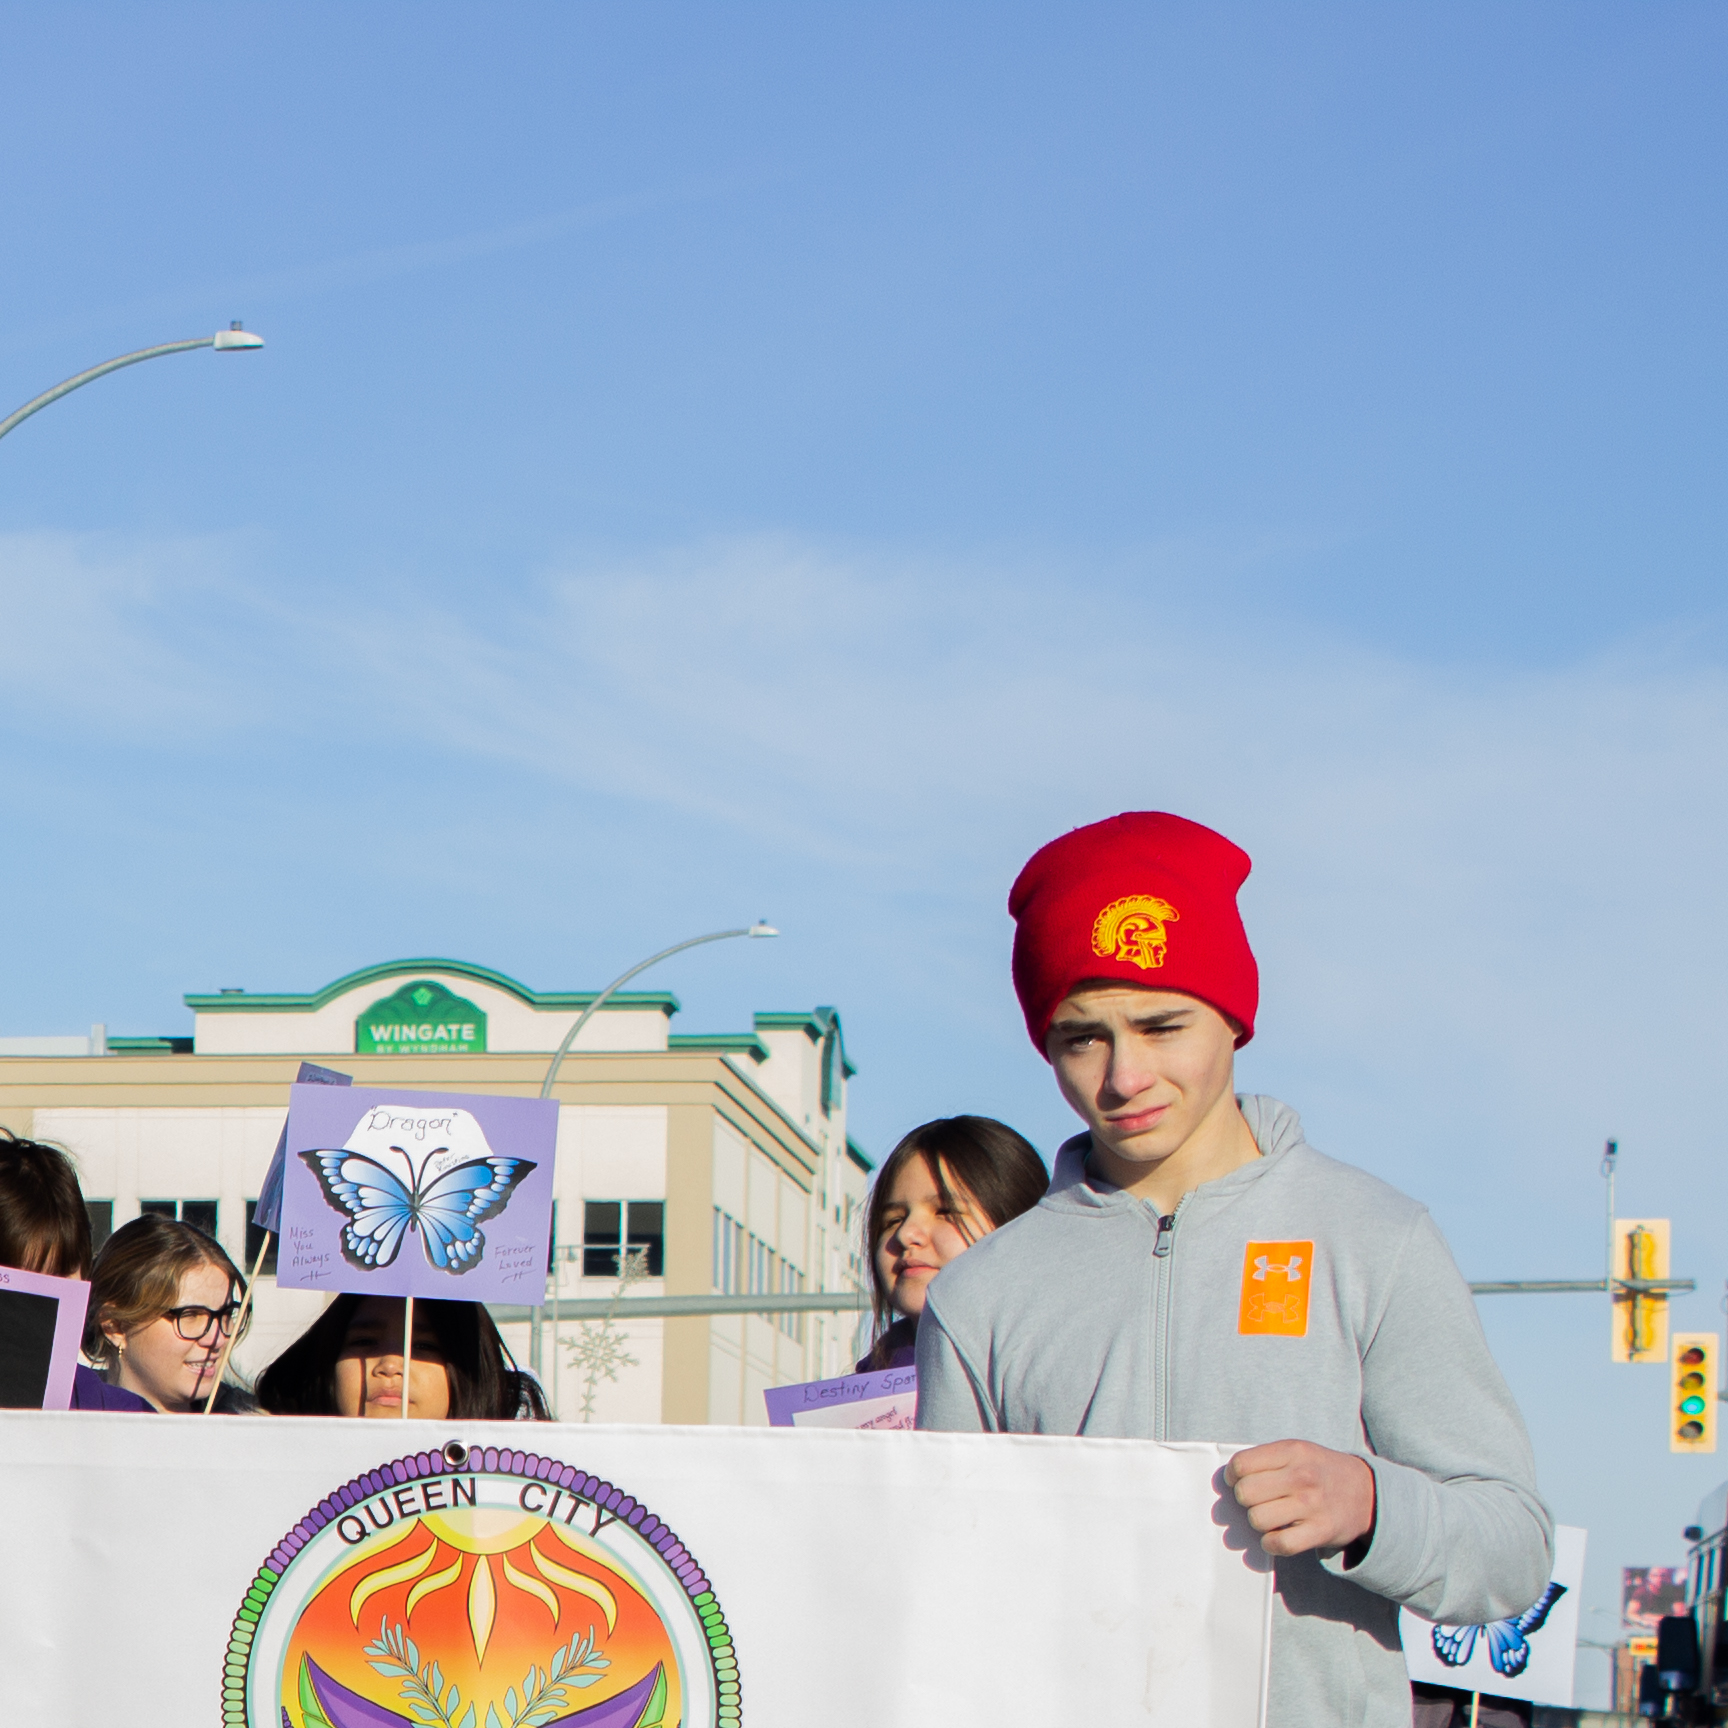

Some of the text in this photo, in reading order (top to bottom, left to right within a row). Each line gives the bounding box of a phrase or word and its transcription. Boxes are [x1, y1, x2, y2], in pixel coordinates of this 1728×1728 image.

[370, 1023, 475, 1041] WINGATE
[376, 1044, 468, 1054] BY WYNDHAM
[290, 1227, 314, 1240] Miss
[294, 1241, 313, 1251] You
[495, 1245, 536, 1259] Forever
[292, 1253, 330, 1268] Always
[499, 1258, 533, 1271] Loved
[803, 1381, 870, 1403] Destiny
[335, 1477, 619, 1545] QUEEN CITY
